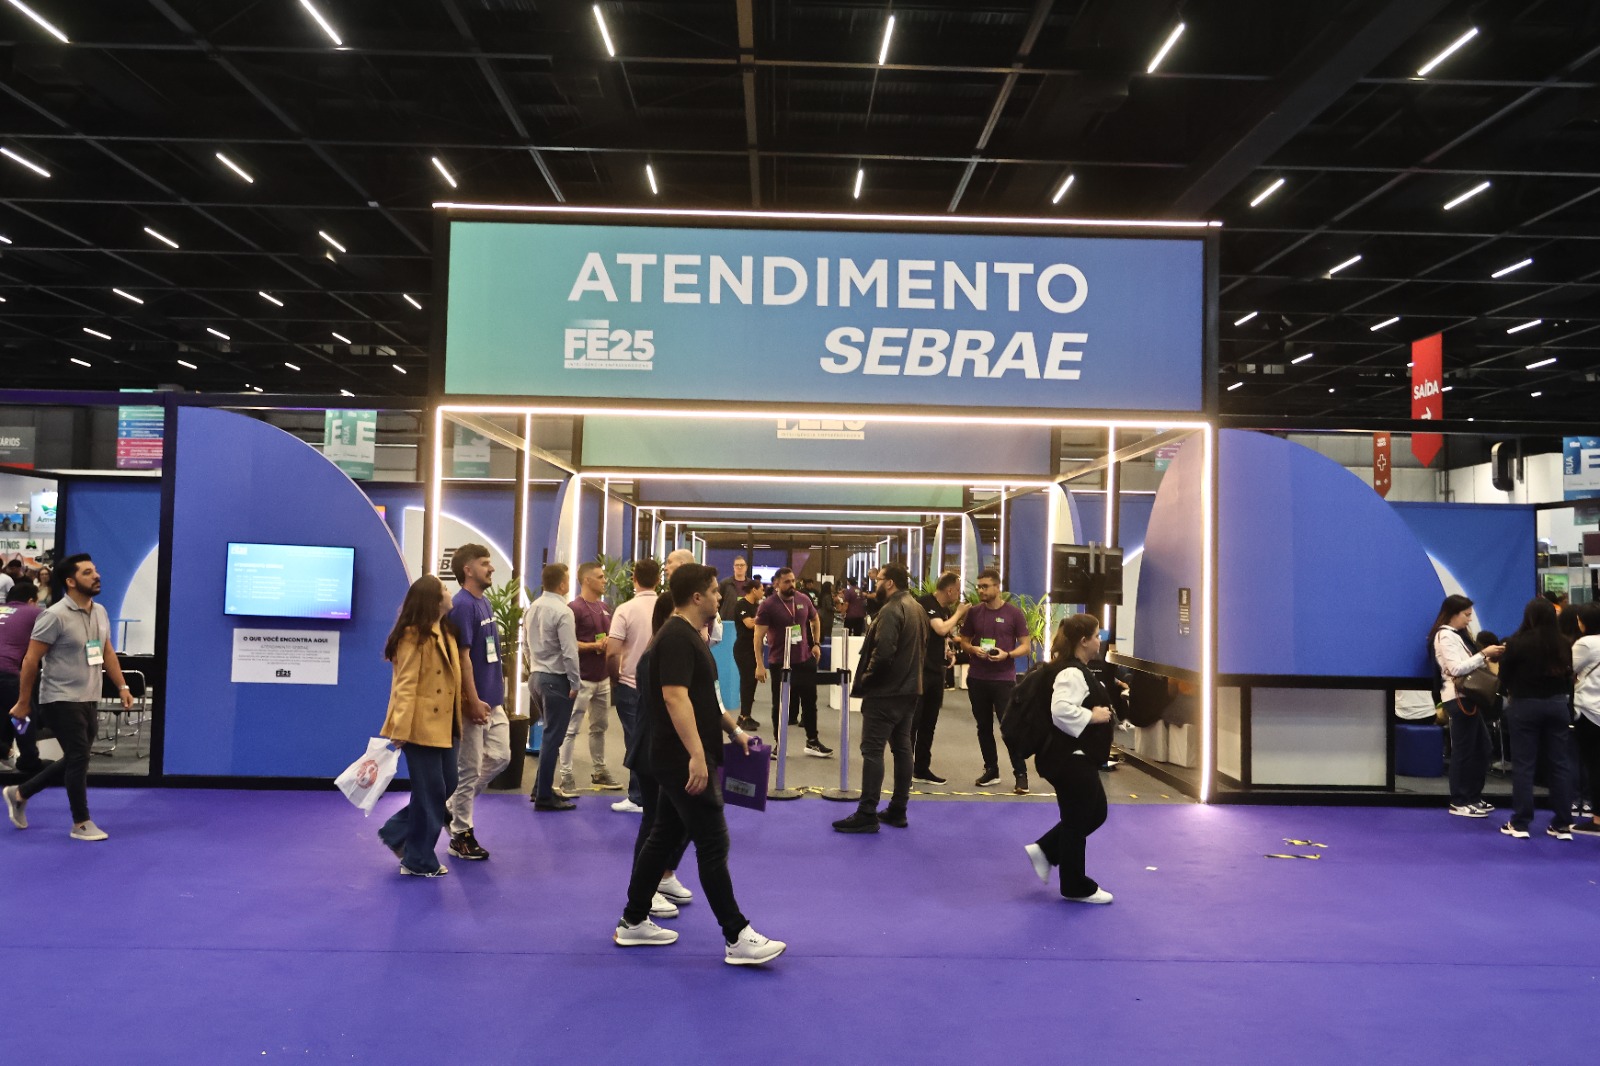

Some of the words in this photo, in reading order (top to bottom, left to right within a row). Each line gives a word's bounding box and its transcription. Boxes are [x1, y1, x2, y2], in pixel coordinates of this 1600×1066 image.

[567, 252, 1088, 314] ATENDIMENTO
[564, 327, 655, 361] FE25
[820, 327, 1088, 381] SEBRAE
[1413, 378, 1440, 401] SAÍDA
[0, 436, 21, 447] ÁRIOS
[342, 425, 350, 444] RUA
[1565, 456, 1574, 475] RUA
